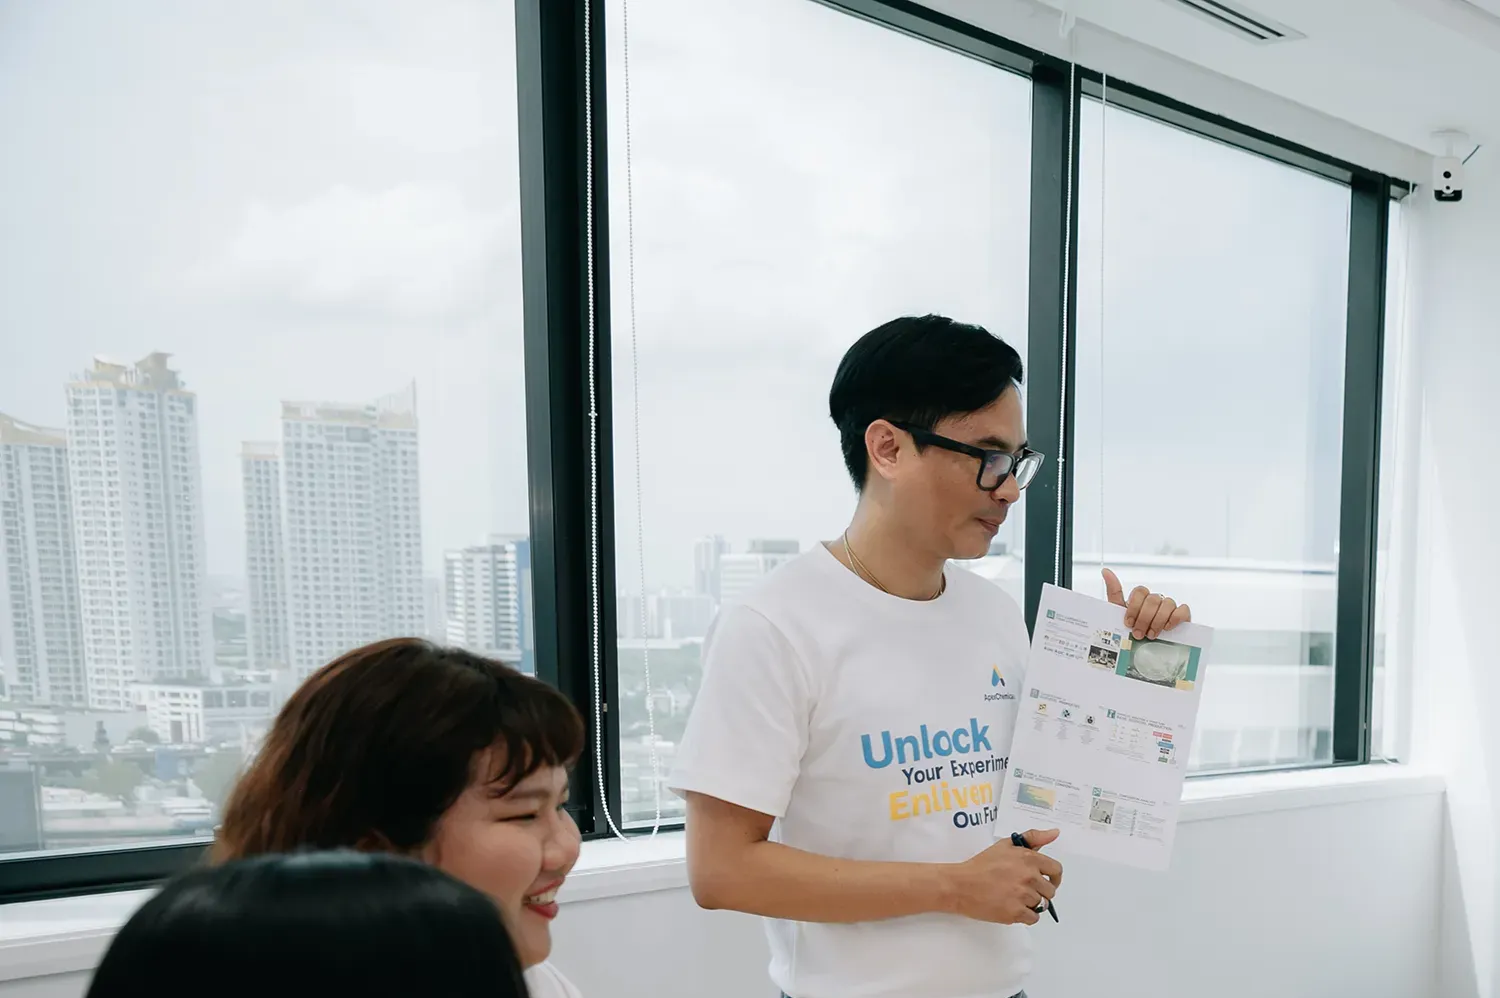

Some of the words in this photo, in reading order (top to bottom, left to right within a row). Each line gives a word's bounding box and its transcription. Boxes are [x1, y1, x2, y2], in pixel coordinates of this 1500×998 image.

[860, 717, 993, 769] Unlock
[901, 765, 943, 785] Your
[888, 781, 993, 821] Enliven
